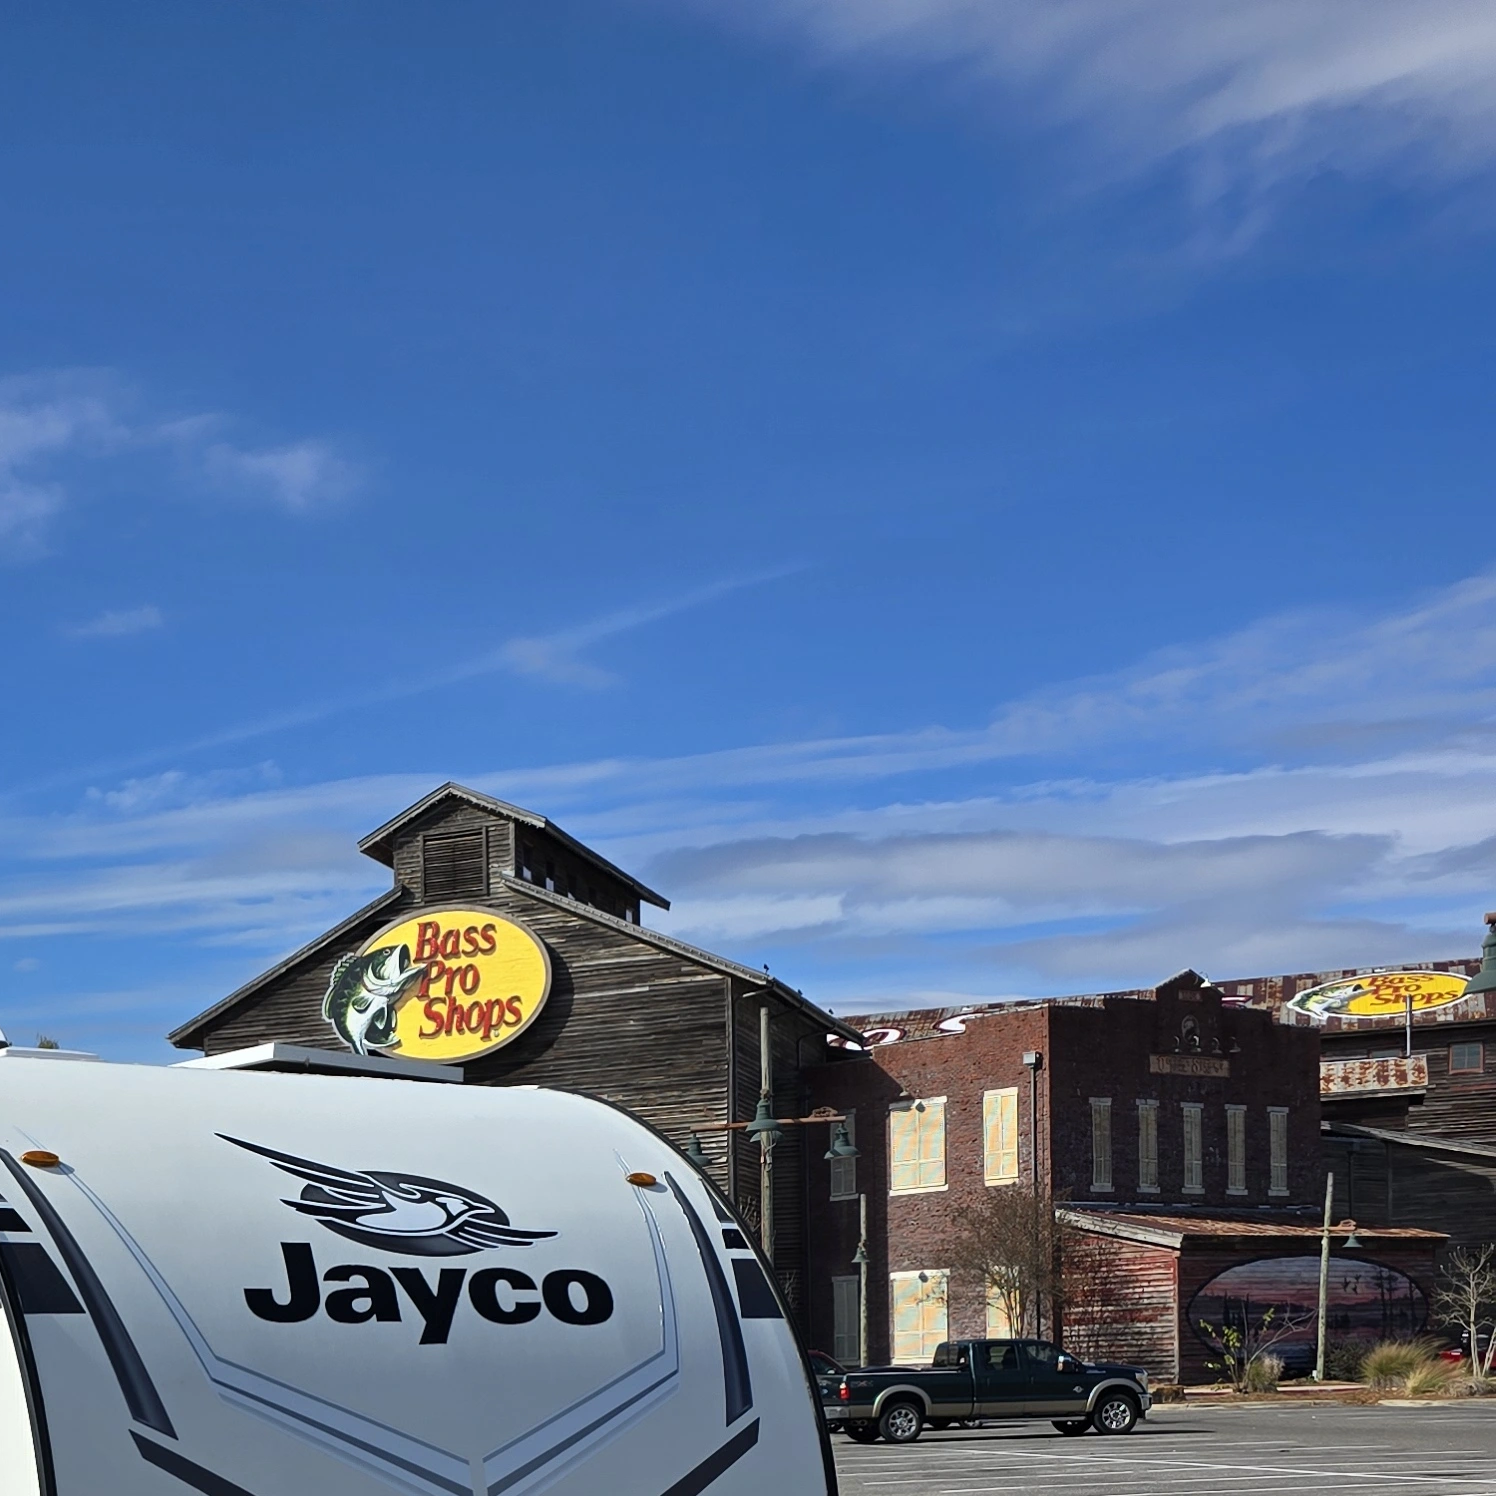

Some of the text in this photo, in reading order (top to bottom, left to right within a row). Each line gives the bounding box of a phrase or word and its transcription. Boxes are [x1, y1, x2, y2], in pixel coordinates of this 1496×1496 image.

[413, 921, 497, 963] Bass
[417, 960, 480, 1000] Pro
[1367, 975, 1434, 986] Bass
[1371, 983, 1422, 995] Pro
[419, 995, 523, 1041] Shops
[244, 1242, 614, 1345] Jayco
